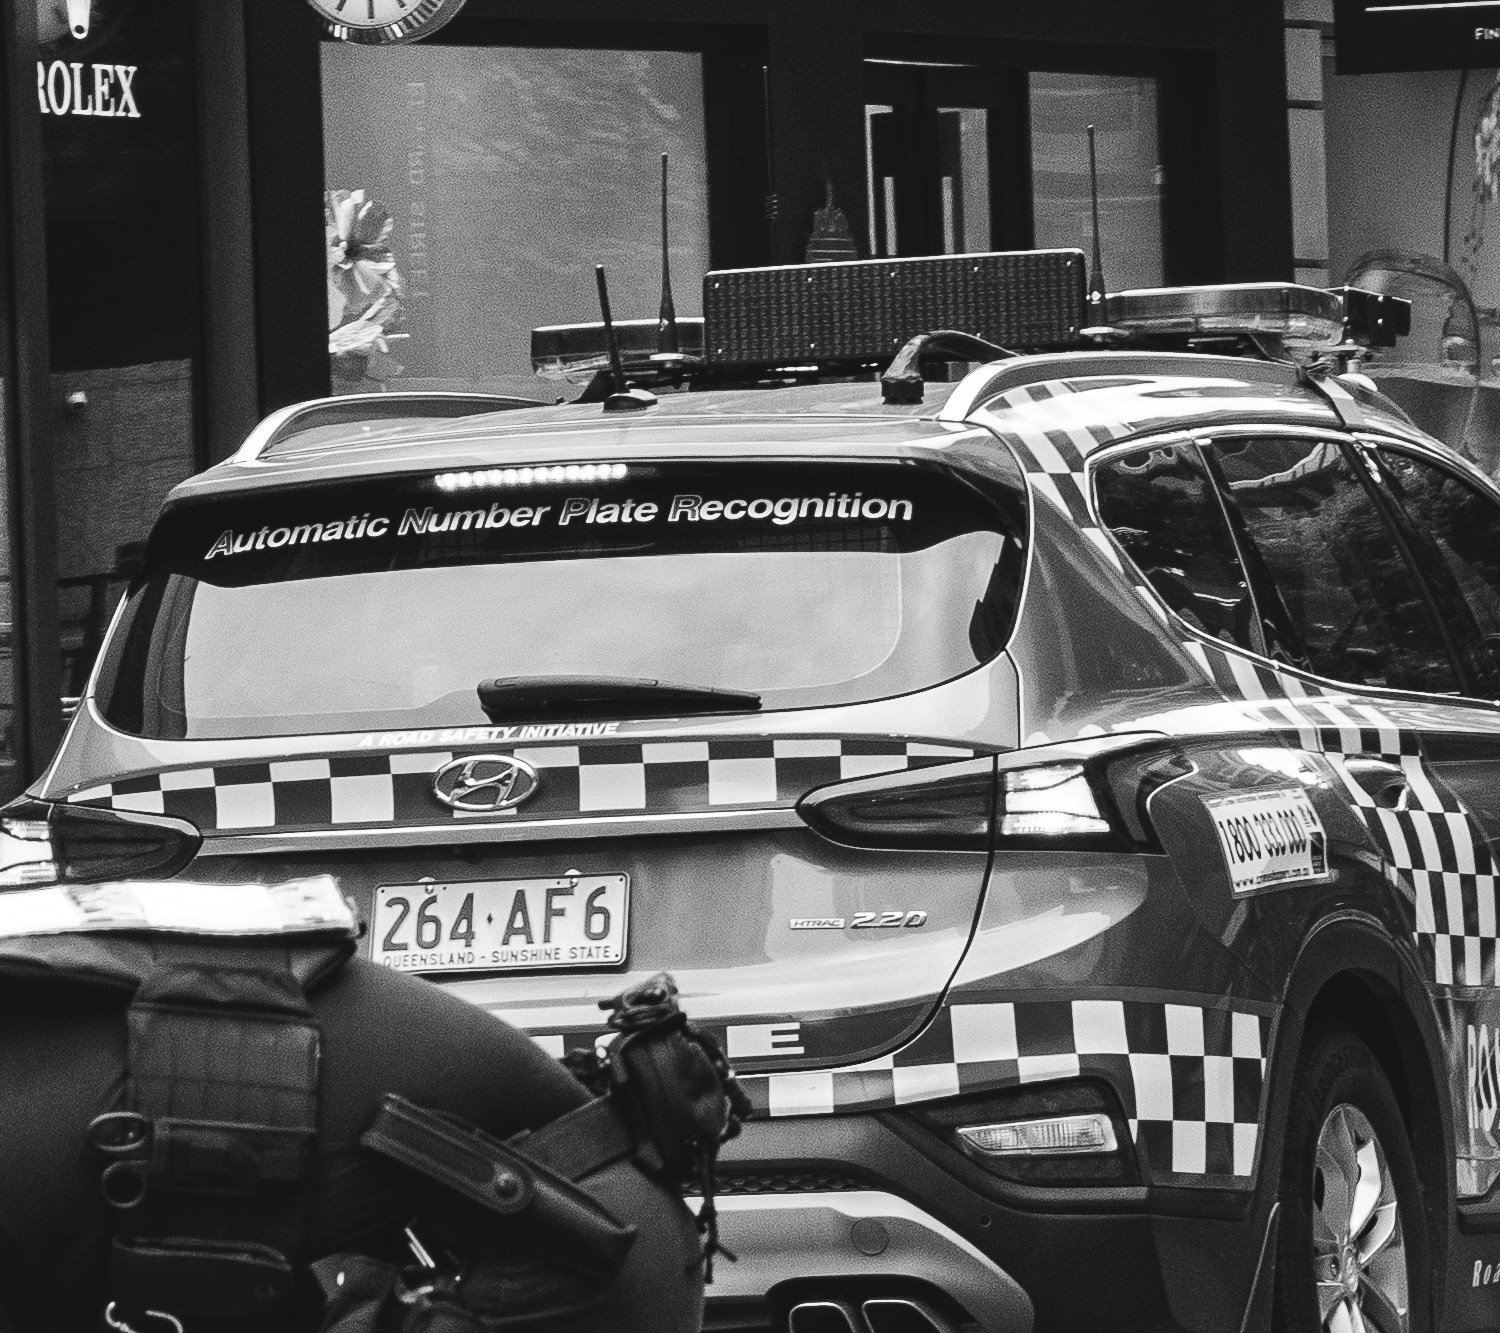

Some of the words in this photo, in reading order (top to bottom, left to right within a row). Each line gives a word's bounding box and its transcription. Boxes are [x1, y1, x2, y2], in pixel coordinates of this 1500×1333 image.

[204, 512, 390, 560] Automatic
[397, 502, 551, 536] Number
[558, 496, 659, 526] Plate
[667, 491, 914, 525] Recognition
[358, 733, 373, 748] A
[377, 730, 432, 747] ROAD
[437, 726, 517, 744] SAFETY
[518, 721, 621, 740] INITIATIVE
[1218, 815, 1262, 865] 1800
[793, 919, 841, 928] HTRAC
[383, 950, 475, 968] QUEENSLAND
[491, 946, 561, 963] SUNSHINE
[569, 944, 611, 960] STATE
